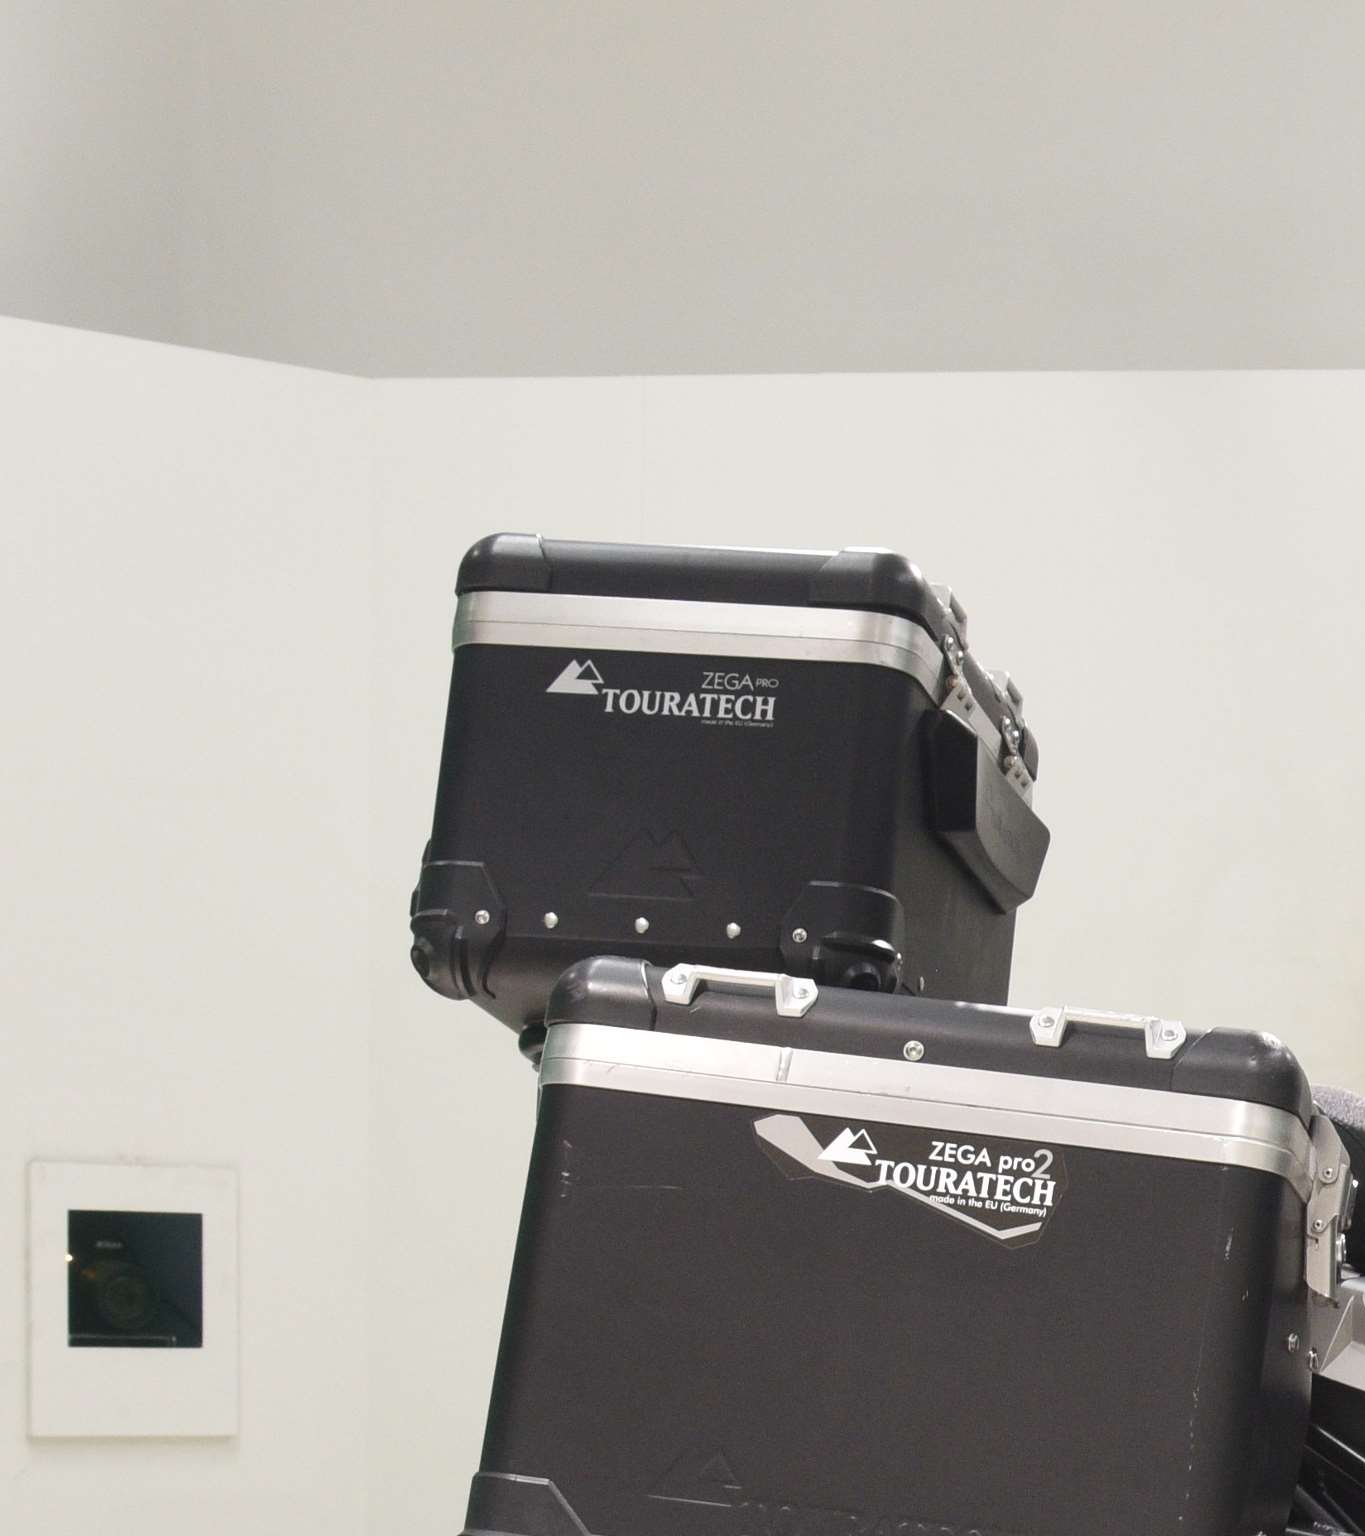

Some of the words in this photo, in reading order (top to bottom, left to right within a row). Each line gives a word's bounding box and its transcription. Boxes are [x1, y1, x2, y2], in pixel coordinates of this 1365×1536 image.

[701, 671, 754, 691] ZEGA
[756, 678, 779, 688] PRO
[602, 688, 776, 720] TOURATECH
[929, 1141, 991, 1167] ZEGA
[875, 1159, 1056, 1206] TOURATECH
[929, 1194, 955, 1204] made
[957, 1196, 966, 1206] in
[968, 1197, 983, 1207] the
[985, 1200, 998, 1210] EU
[1000, 1202, 1047, 1217] (Germany)
